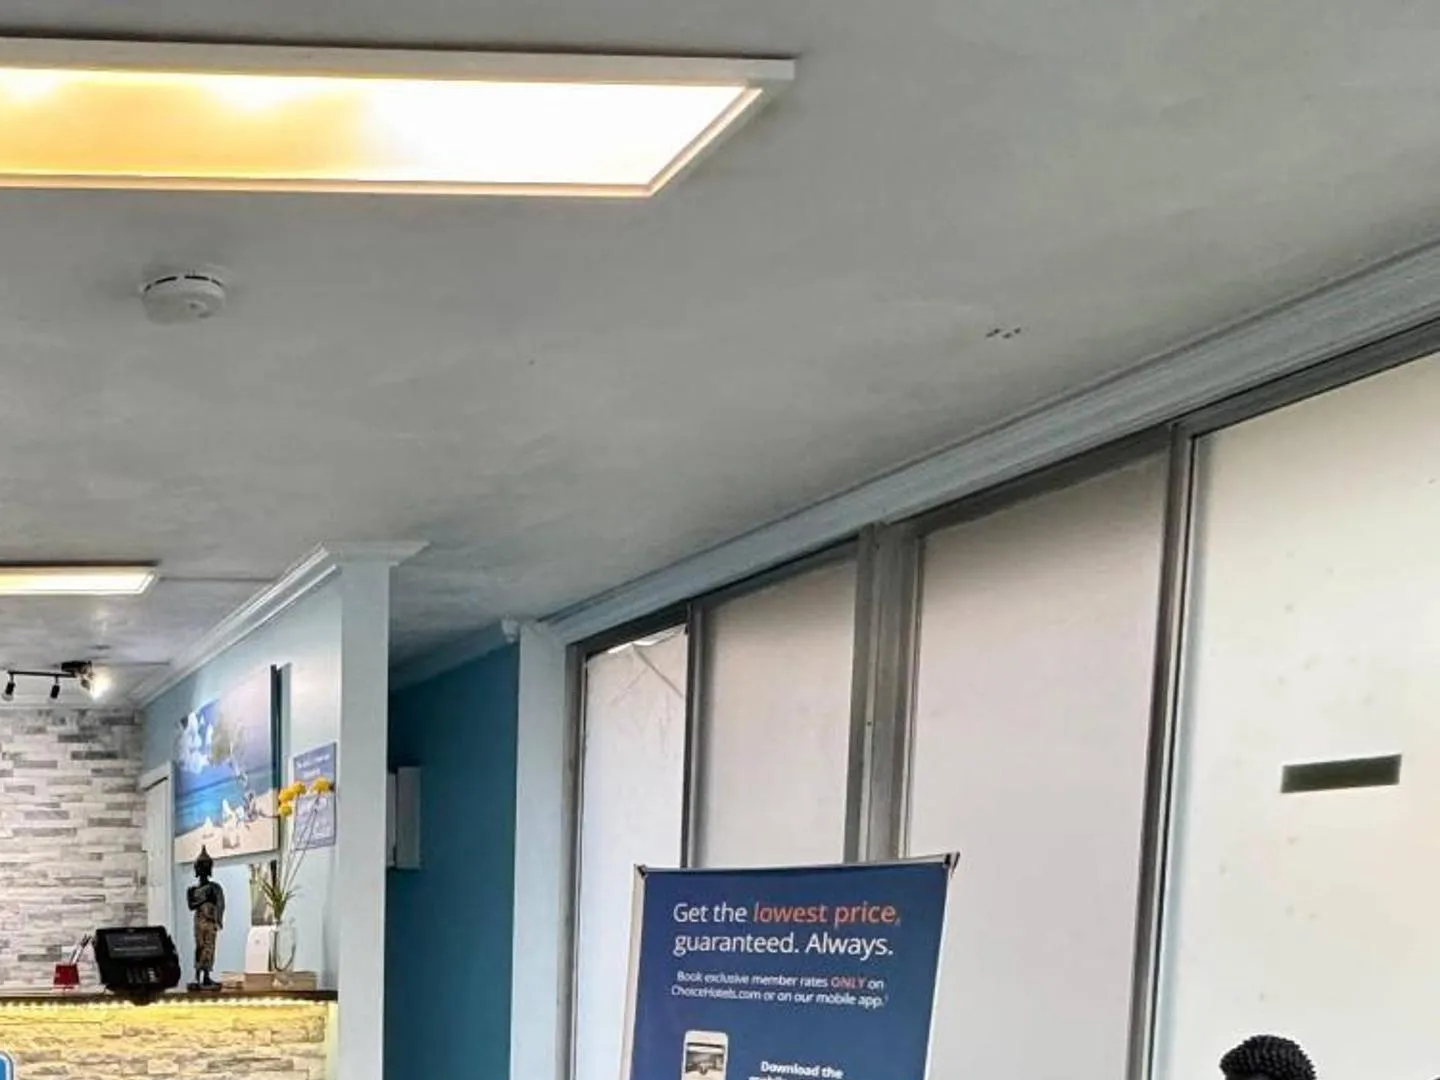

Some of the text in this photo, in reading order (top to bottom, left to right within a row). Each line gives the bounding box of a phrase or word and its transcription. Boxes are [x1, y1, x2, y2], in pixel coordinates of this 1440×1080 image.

[673, 903, 708, 922] Get
[713, 902, 747, 922] the
[753, 902, 827, 923] lowest
[672, 931, 894, 961] guaranteed. Always.
[677, 971, 884, 991] Book exclusive member rates ONLY on
[671, 985, 761, 1000] ChoiceHotels.com
[763, 990, 776, 1001] or
[777, 991, 792, 1002] on
[794, 992, 813, 1003] our
[816, 992, 857, 1006] mobile
[761, 1061, 844, 1080] Download the
